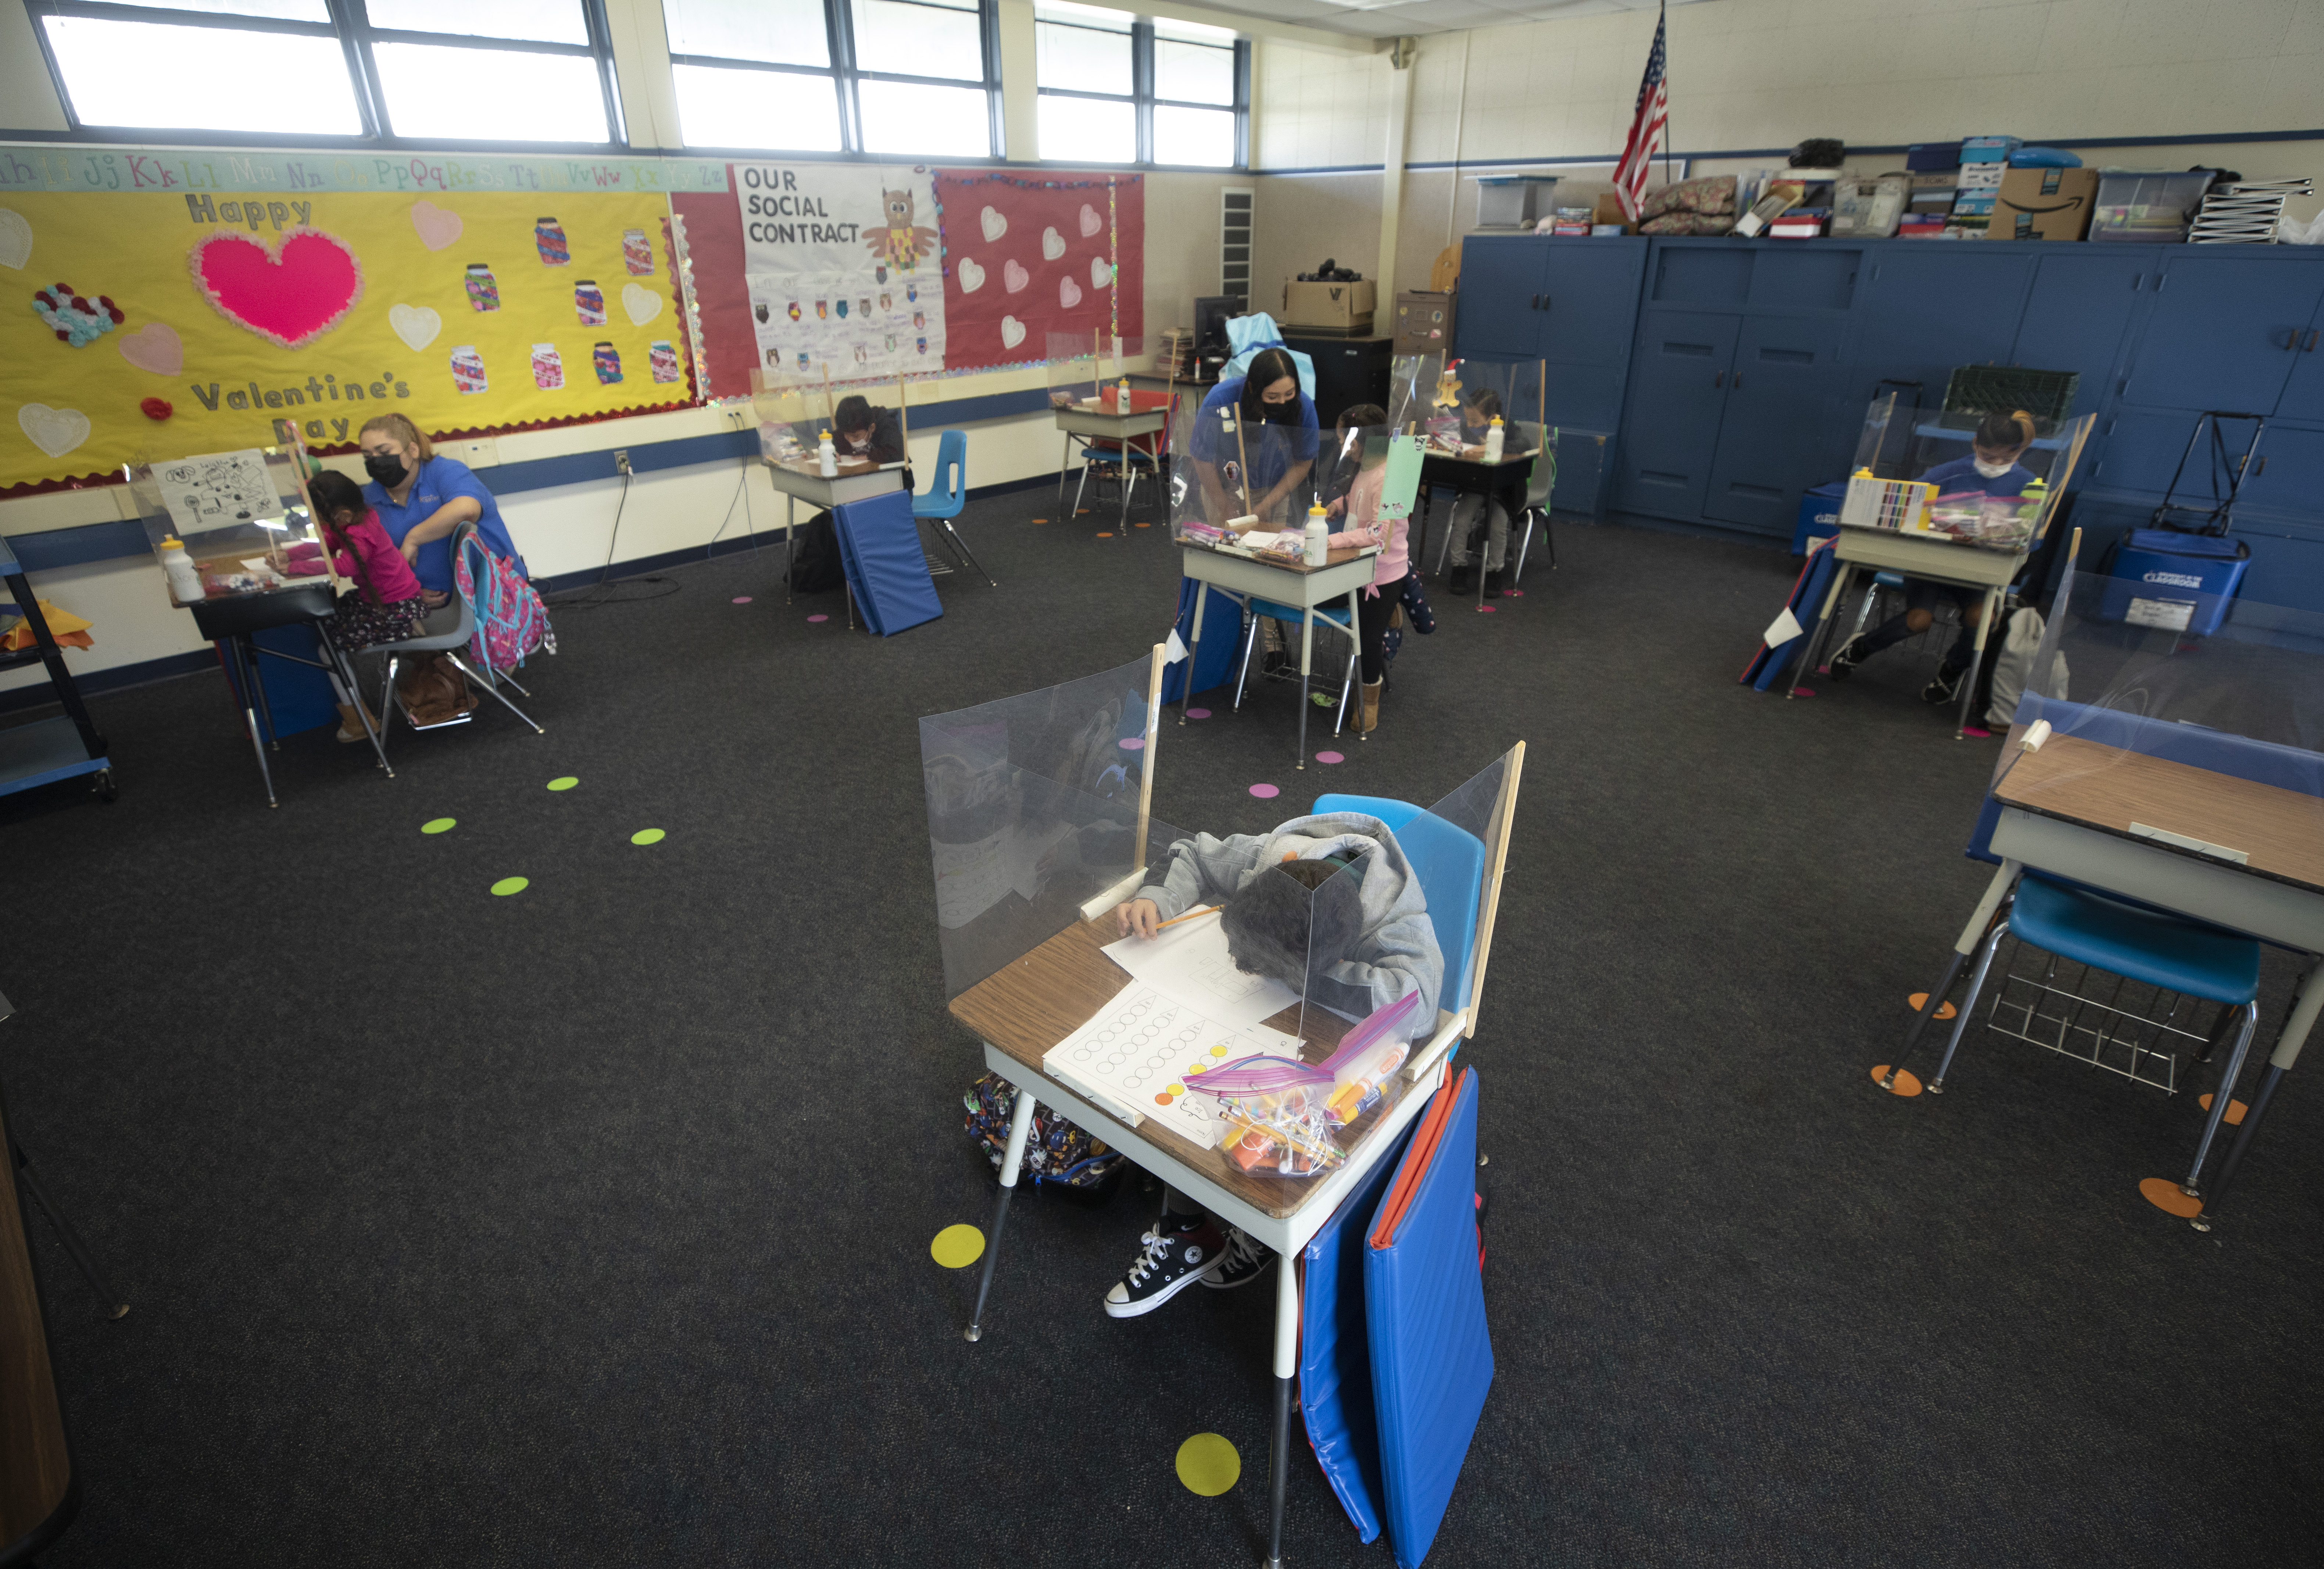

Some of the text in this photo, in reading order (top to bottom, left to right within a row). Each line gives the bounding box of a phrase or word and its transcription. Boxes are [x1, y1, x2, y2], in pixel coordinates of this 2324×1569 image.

[84, 154, 120, 189] Jj
[125, 155, 178, 187] Kk
[179, 161, 220, 188] Ll
[227, 156, 276, 183] Mm
[287, 162, 325, 188] Nn
[334, 160, 367, 185] Oo
[372, 159, 410, 190] Pp
[410, 158, 447, 190] Qq
[446, 161, 476, 188] Rr
[479, 163, 504, 187] Ss
[509, 164, 538, 190] Tt
[566, 162, 590, 183] Vv
[591, 166, 621, 186] Ww
[629, 165, 658, 190] Xx
[666, 164, 691, 189] Yy
[699, 165, 722, 186] Zz
[744, 167, 797, 191] OUR
[185, 194, 311, 231] Happy
[748, 194, 828, 217] SOCIAL
[749, 222, 859, 243] CONTRACT
[190, 371, 410, 411] Valentine's
[272, 417, 349, 445] Day
